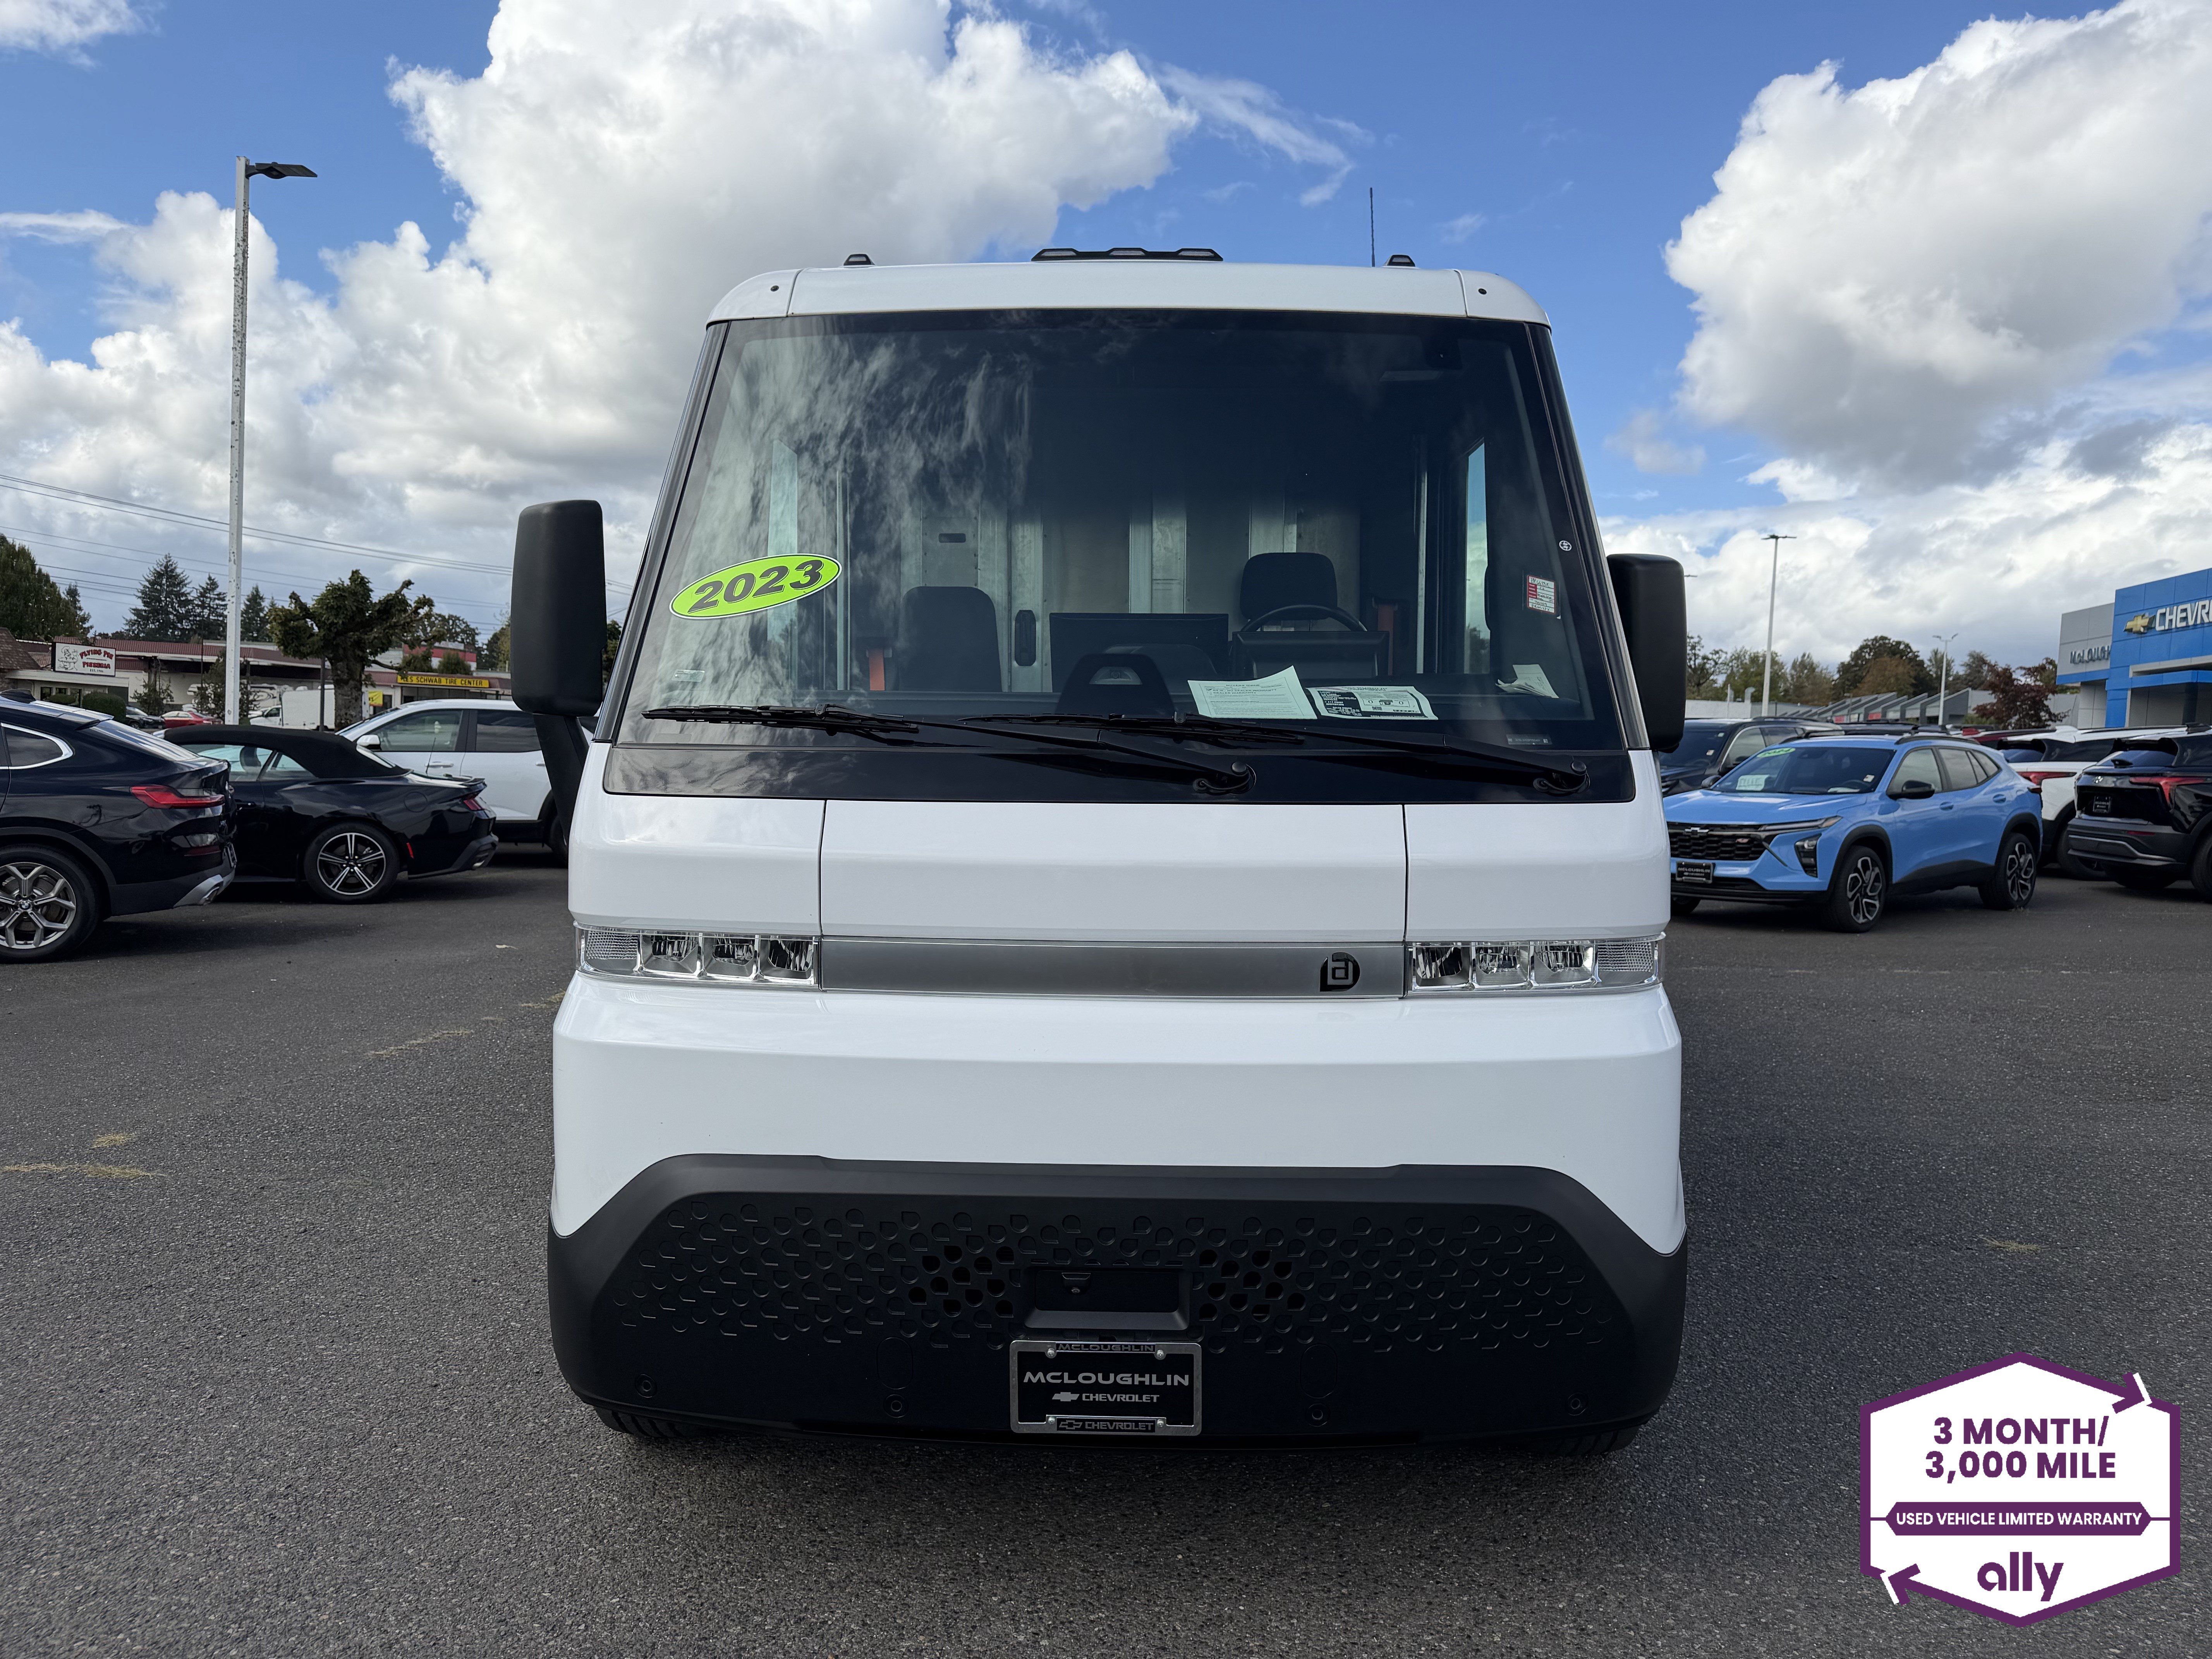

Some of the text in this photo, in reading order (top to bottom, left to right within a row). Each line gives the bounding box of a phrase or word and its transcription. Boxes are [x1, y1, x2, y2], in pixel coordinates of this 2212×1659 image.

[687, 560, 824, 614] 2023
[79, 649, 102, 659] FLYING
[1058, 1343, 1154, 1352] MCLOUGHLIN
[1024, 1371, 1189, 1386] MCLOUGHLIN
[1082, 1393, 1160, 1403] CHEVROLET
[1085, 1421, 1154, 1431] CHEVROLET
